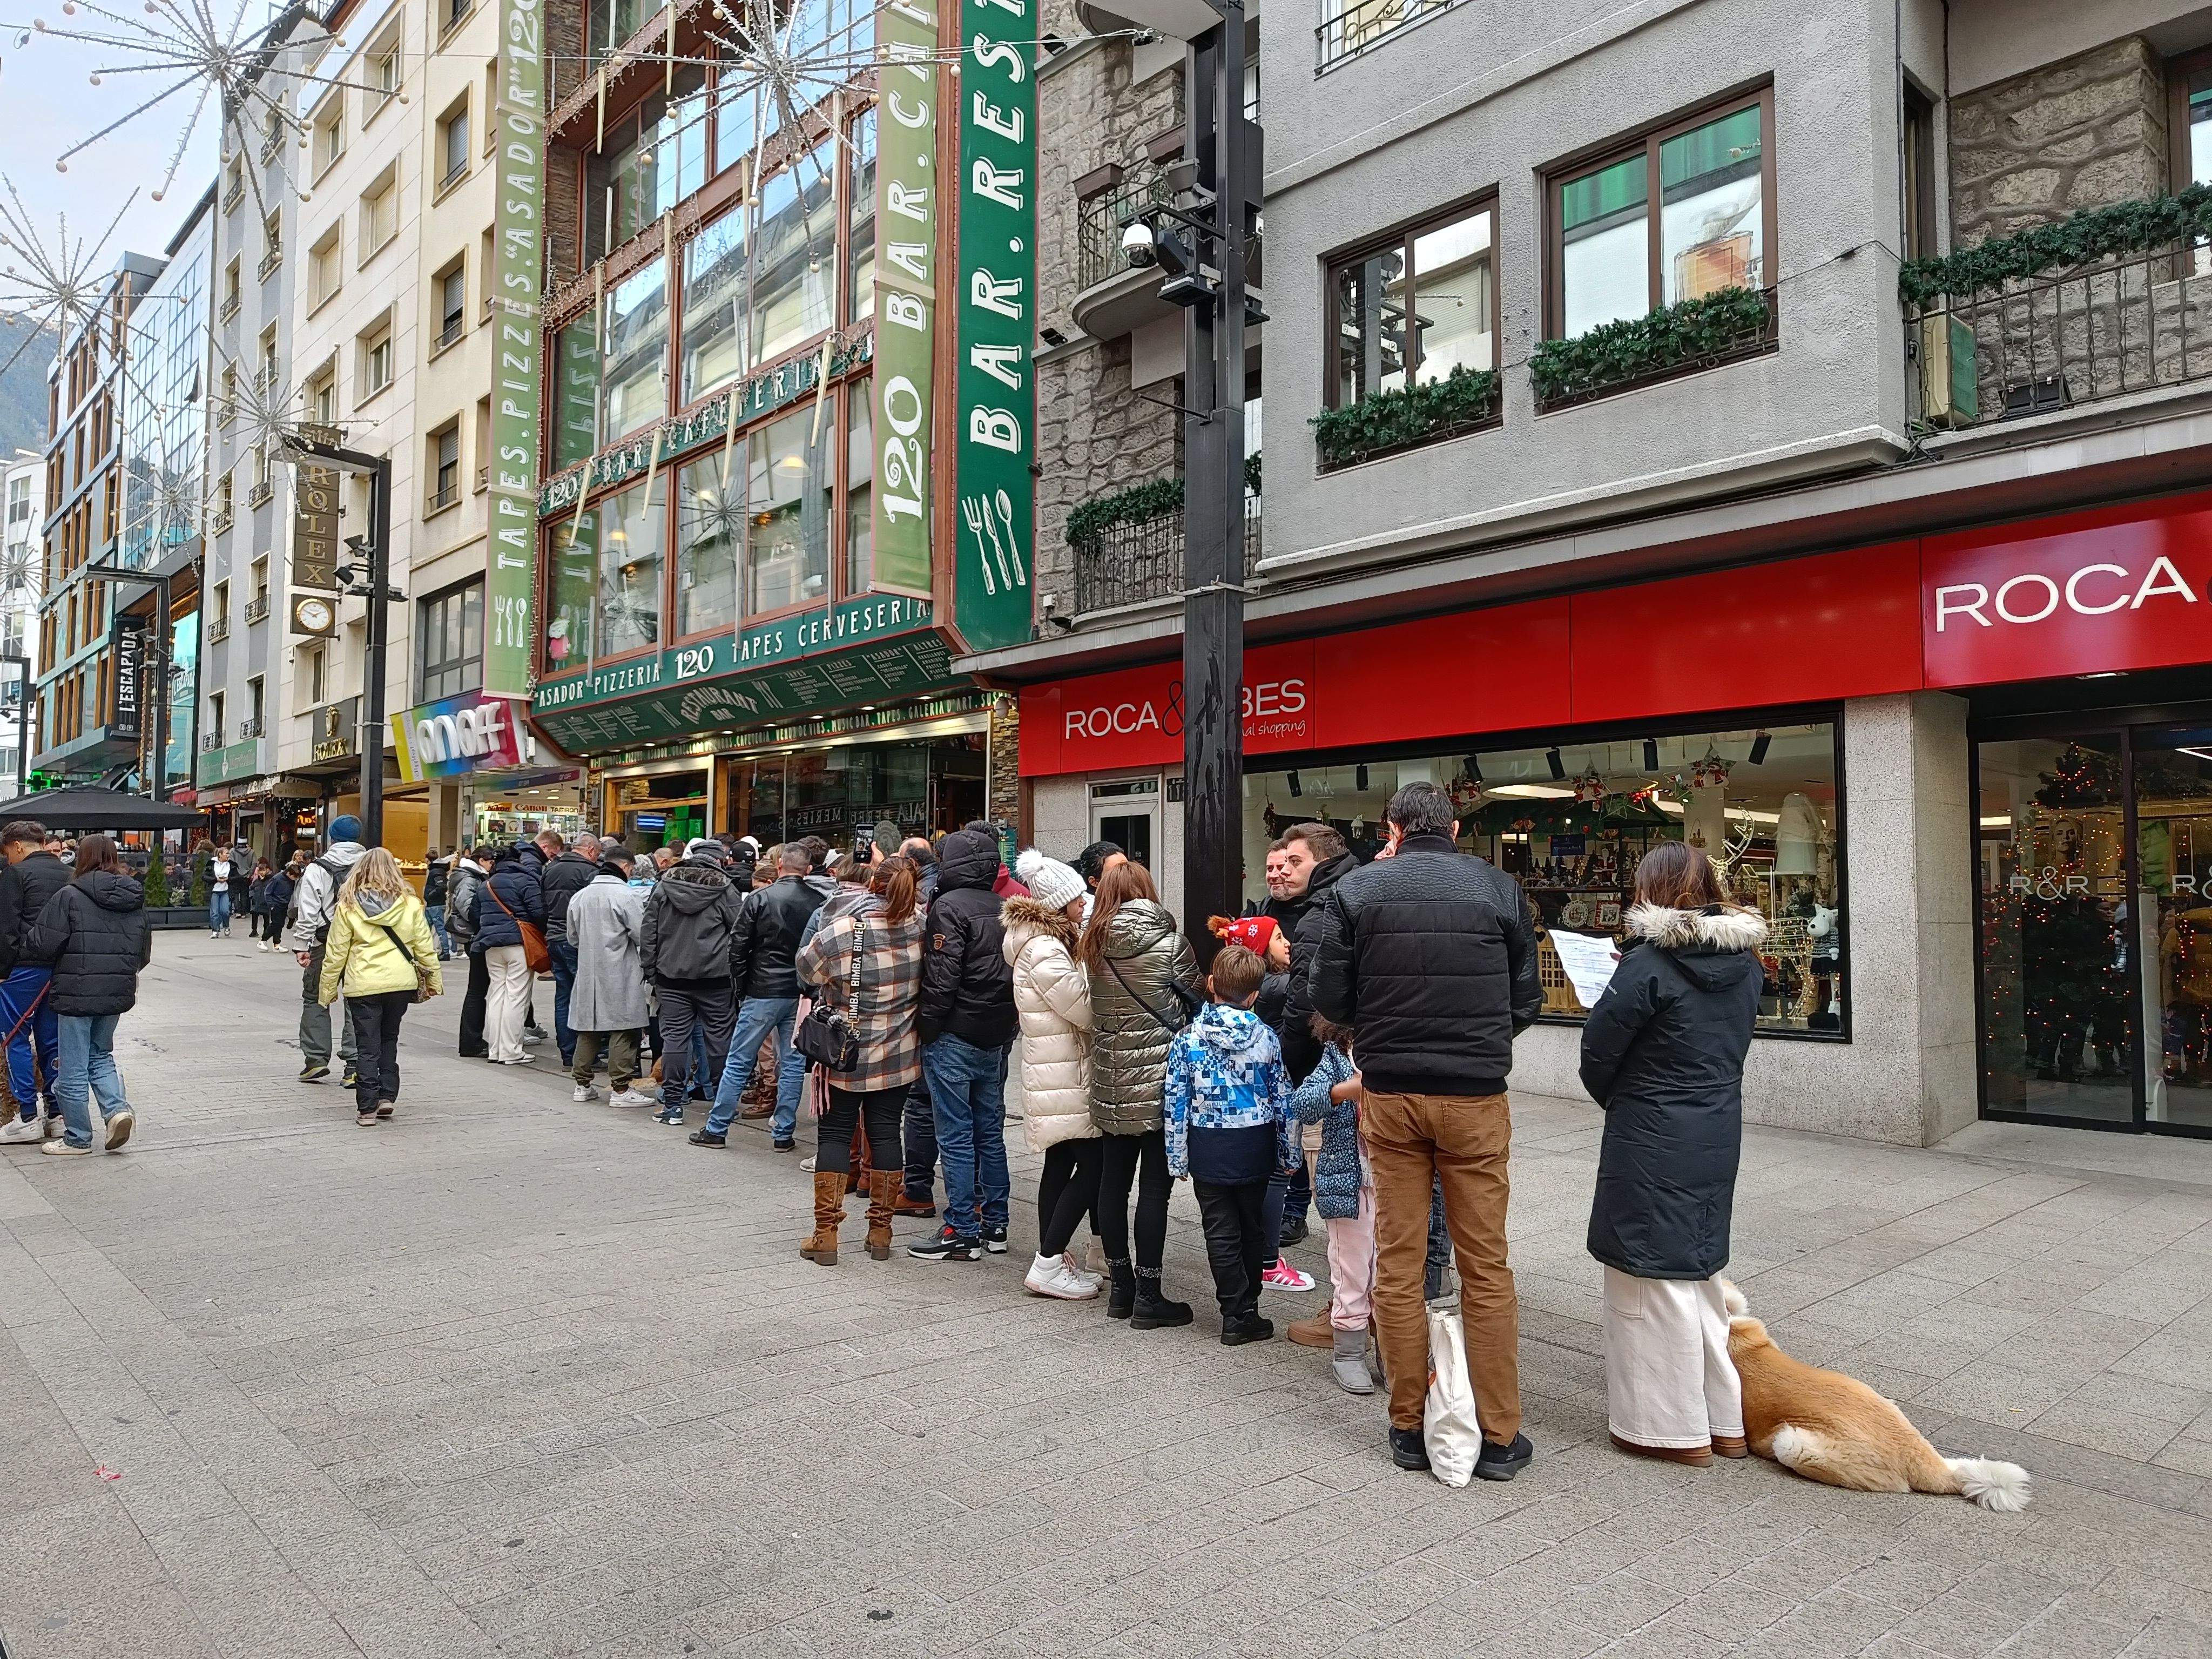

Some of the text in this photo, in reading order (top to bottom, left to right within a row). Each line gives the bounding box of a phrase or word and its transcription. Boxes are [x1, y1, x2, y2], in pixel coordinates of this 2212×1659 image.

[883, 376, 923, 523] 120
[549, 476, 578, 509] 120
[304, 466, 329, 584] ROLEX
[1936, 556, 2198, 632] ROCA
[732, 631, 783, 663] TAPES
[913, 639, 942, 651] ALTRES
[595, 663, 660, 695] PIZZERIA
[675, 645, 714, 680] 120
[681, 686, 759, 725] RESTAURANT
[710, 707, 736, 721] BAR
[832, 717, 853, 732] MUSIC
[908, 700, 945, 720] GALERIA
[1065, 701, 1159, 739] ROCA
[416, 702, 505, 764] onoff
[1258, 719, 1306, 738] shopping
[515, 803, 548, 812] Canon
[851, 956, 861, 987] BIMBA
